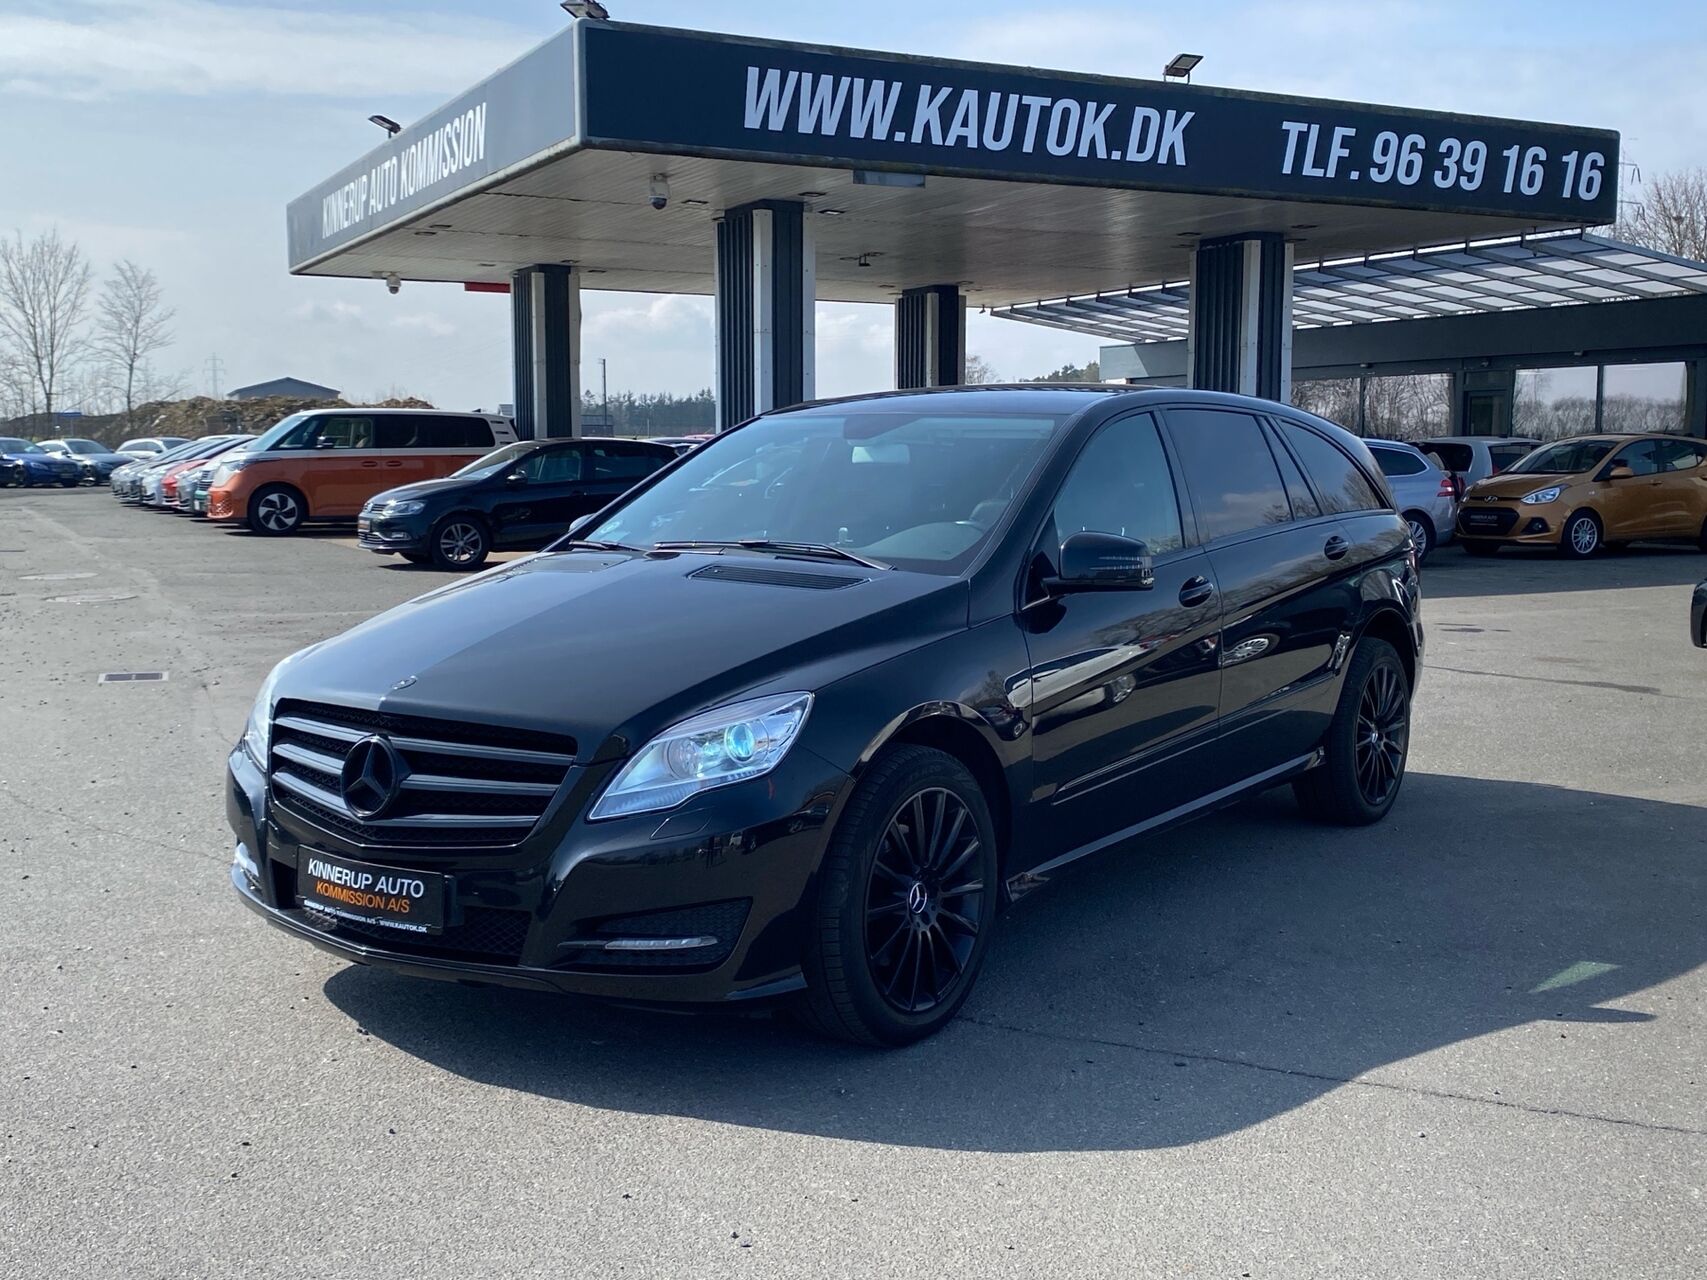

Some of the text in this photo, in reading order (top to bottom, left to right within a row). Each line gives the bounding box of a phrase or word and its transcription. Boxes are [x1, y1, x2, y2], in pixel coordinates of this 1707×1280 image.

[743, 66, 1196, 166] WWW.KAUTOK.DK
[322, 102, 487, 239] KINNERUP AUTO KOMMISSION
[1281, 120, 1605, 201] TLF. 96 39 16 16
[308, 858, 424, 898] KINNERUP AUTO
[316, 881, 410, 913] KOMMISSION A/S
